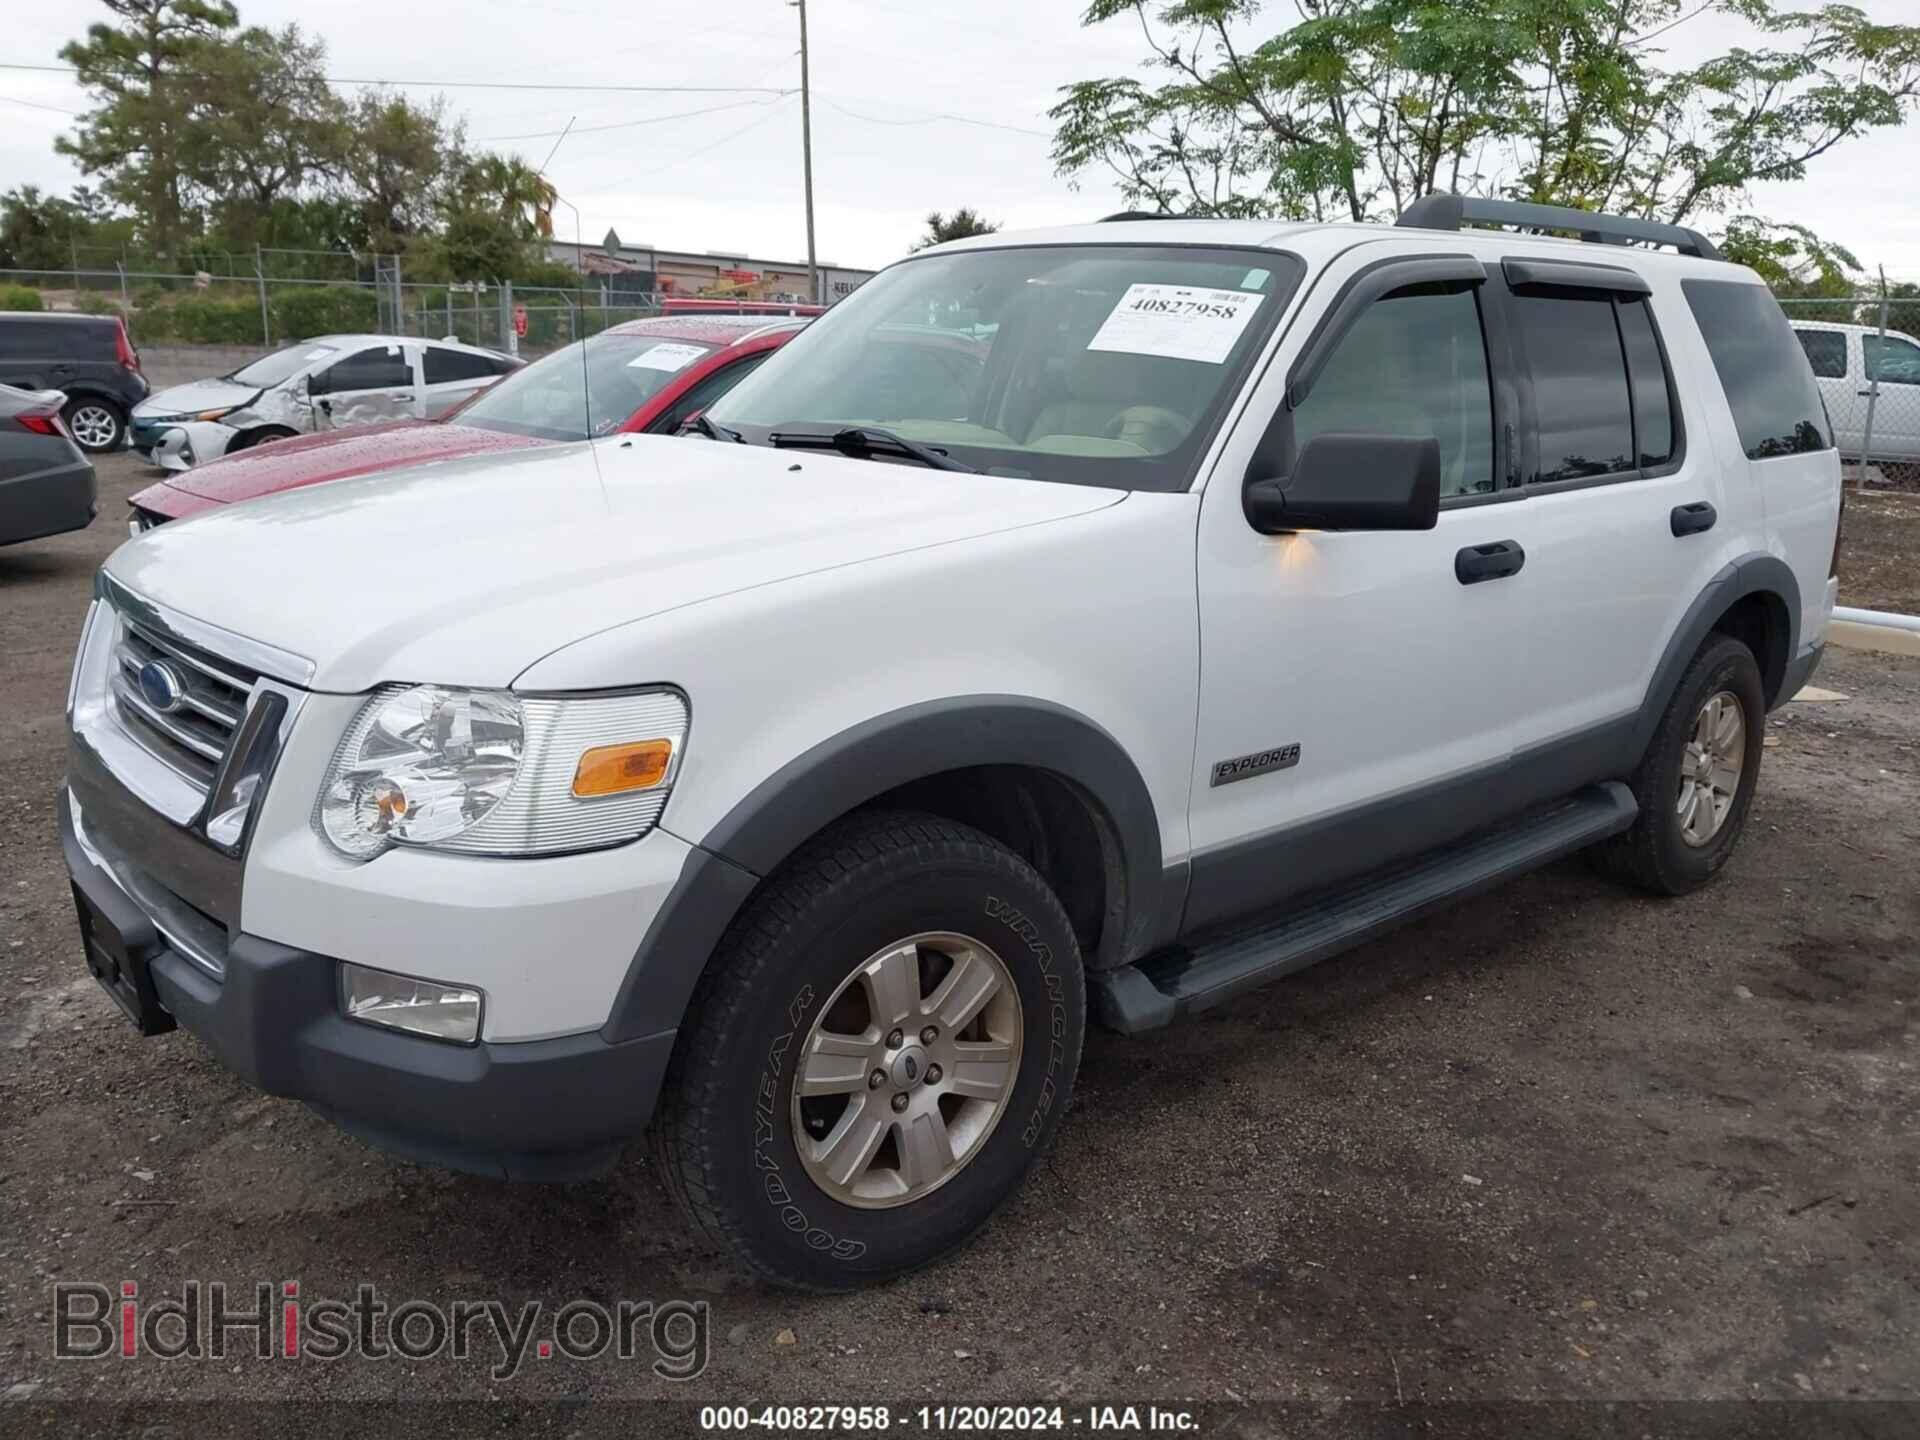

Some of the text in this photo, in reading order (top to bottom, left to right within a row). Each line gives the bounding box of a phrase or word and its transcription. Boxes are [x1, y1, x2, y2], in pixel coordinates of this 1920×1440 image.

[1130, 298, 1238, 320] 40827958
[1218, 745, 1301, 778] EXPLORER
[984, 896, 1067, 1148] WRANGLER
[755, 983, 867, 1260] GOODYEAR
